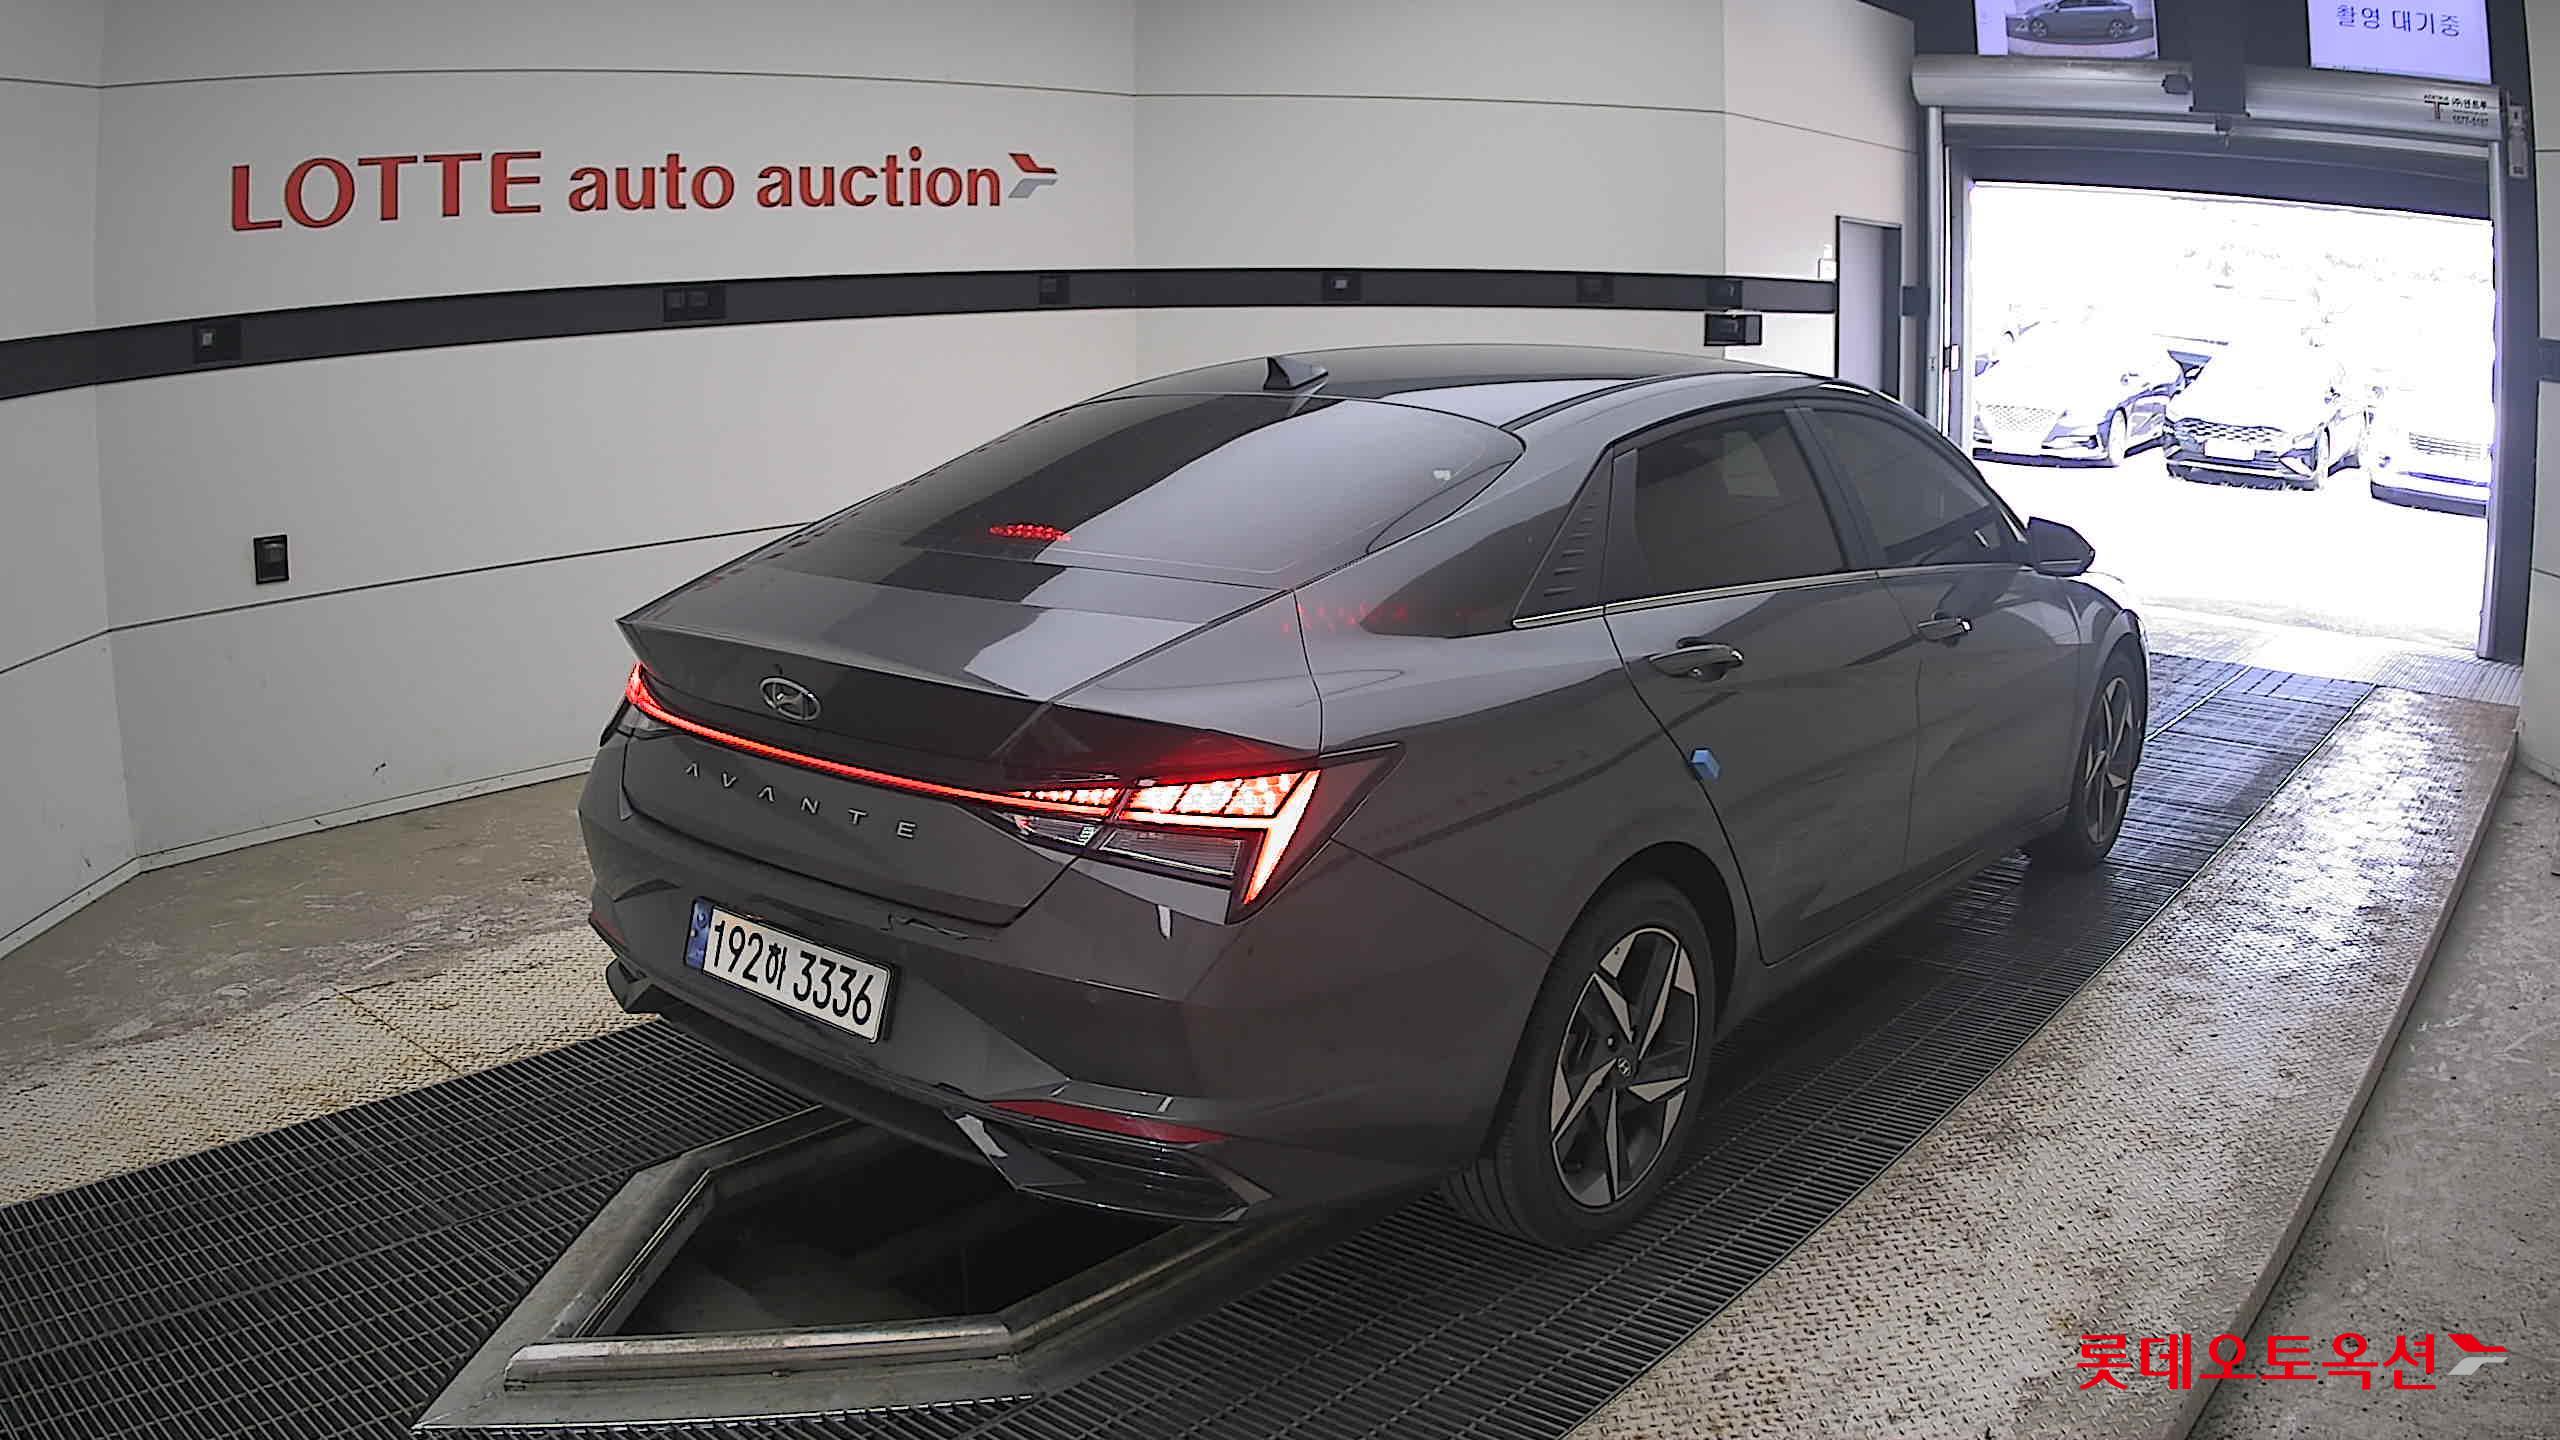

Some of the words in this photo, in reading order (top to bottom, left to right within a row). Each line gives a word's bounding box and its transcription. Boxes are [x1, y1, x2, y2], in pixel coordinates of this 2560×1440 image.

[2337, 4, 2380, 30] 촬영
[2392, 10, 2460, 37] 대기중
[231, 151, 541, 232] LOTTE
[568, 153, 735, 212] auto
[756, 146, 1000, 208] auction
[685, 762, 917, 839] AVANTE
[793, 950, 874, 1026] 3336
